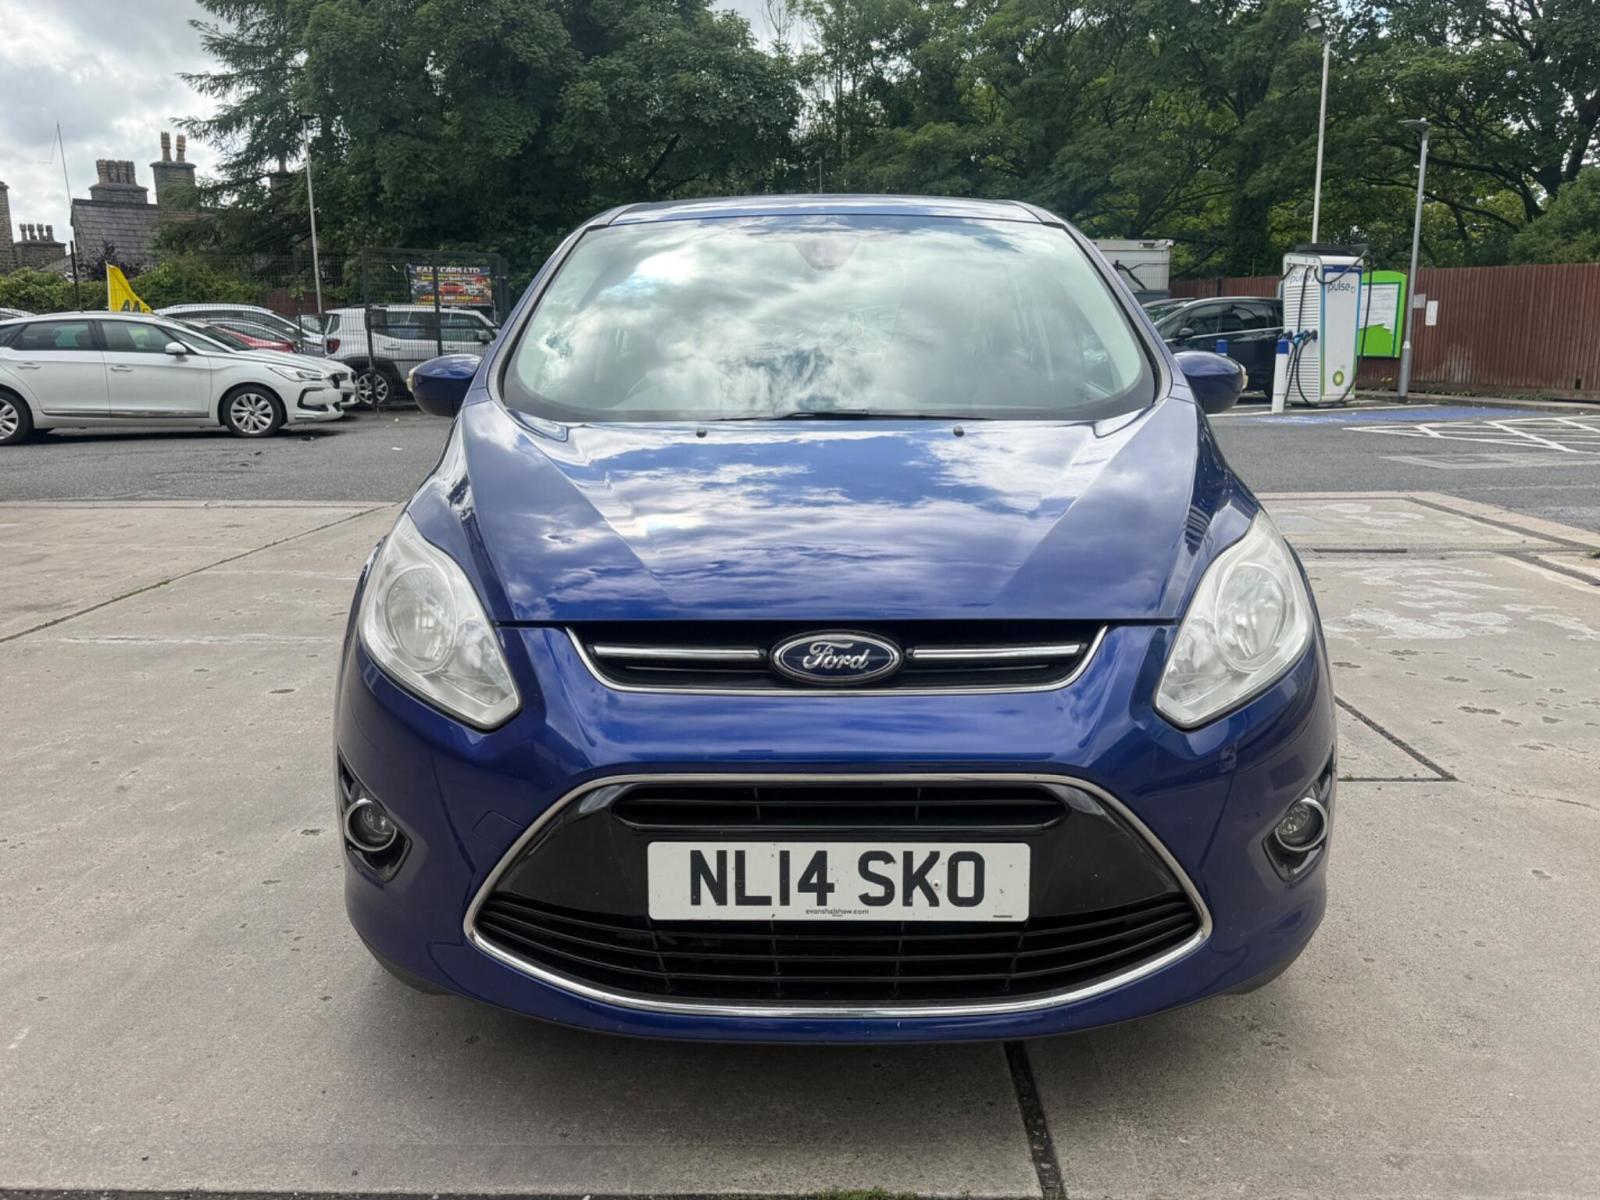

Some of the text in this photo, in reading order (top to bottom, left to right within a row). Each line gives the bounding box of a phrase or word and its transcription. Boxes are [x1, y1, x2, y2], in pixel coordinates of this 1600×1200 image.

[1327, 281, 1351, 294] pulse
[802, 641, 870, 669] Ford
[690, 850, 985, 907] NL14 SKO
